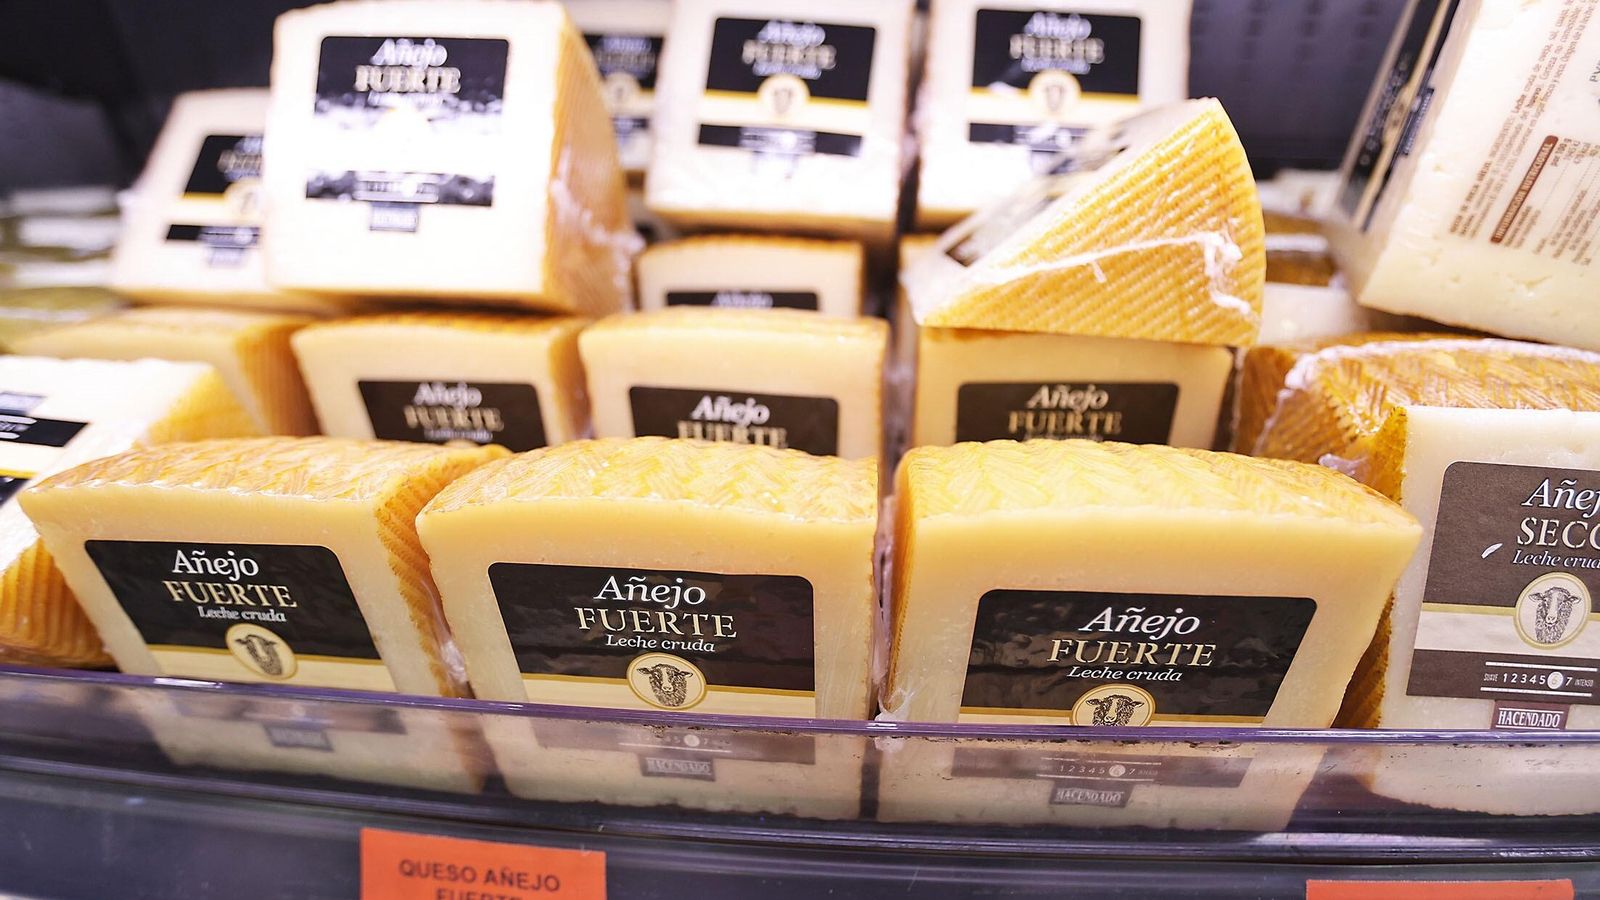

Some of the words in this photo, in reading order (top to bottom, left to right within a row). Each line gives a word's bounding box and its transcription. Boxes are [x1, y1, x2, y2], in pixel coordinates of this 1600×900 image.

[1559, 41, 1579, 63] Origen
[691, 395, 770, 427] Añejo
[1026, 384, 1109, 412] Añejo
[1008, 411, 1122, 434] FUERTE
[1521, 478, 1600, 518] Añej
[172, 550, 259, 581] Añejo
[1512, 549, 1561, 566] Leche
[162, 580, 298, 608] FUERTE
[593, 575, 706, 609] Añejo
[197, 606, 240, 621] Leche
[241, 608, 287, 622] cruda
[574, 607, 737, 638] FUERTE
[1078, 606, 1200, 640] Añejo
[605, 634, 657, 649] Leche
[661, 639, 715, 652] cruda
[1046, 639, 1217, 667] FUERTE
[1066, 666, 1123, 679] Leche
[1126, 668, 1183, 682] cruda
[1503, 673, 1508, 682] 1
[1511, 673, 1518, 683] 2
[1521, 674, 1528, 684] 3
[1529, 675, 1537, 685] 4
[1540, 675, 1546, 685] 5
[1565, 677, 1573, 686] 7
[1498, 711, 1561, 728] HACENDADO
[1055, 790, 1122, 803] HACENDADO
[399, 859, 477, 884] QUESO
[484, 866, 560, 892] AÑEJO
